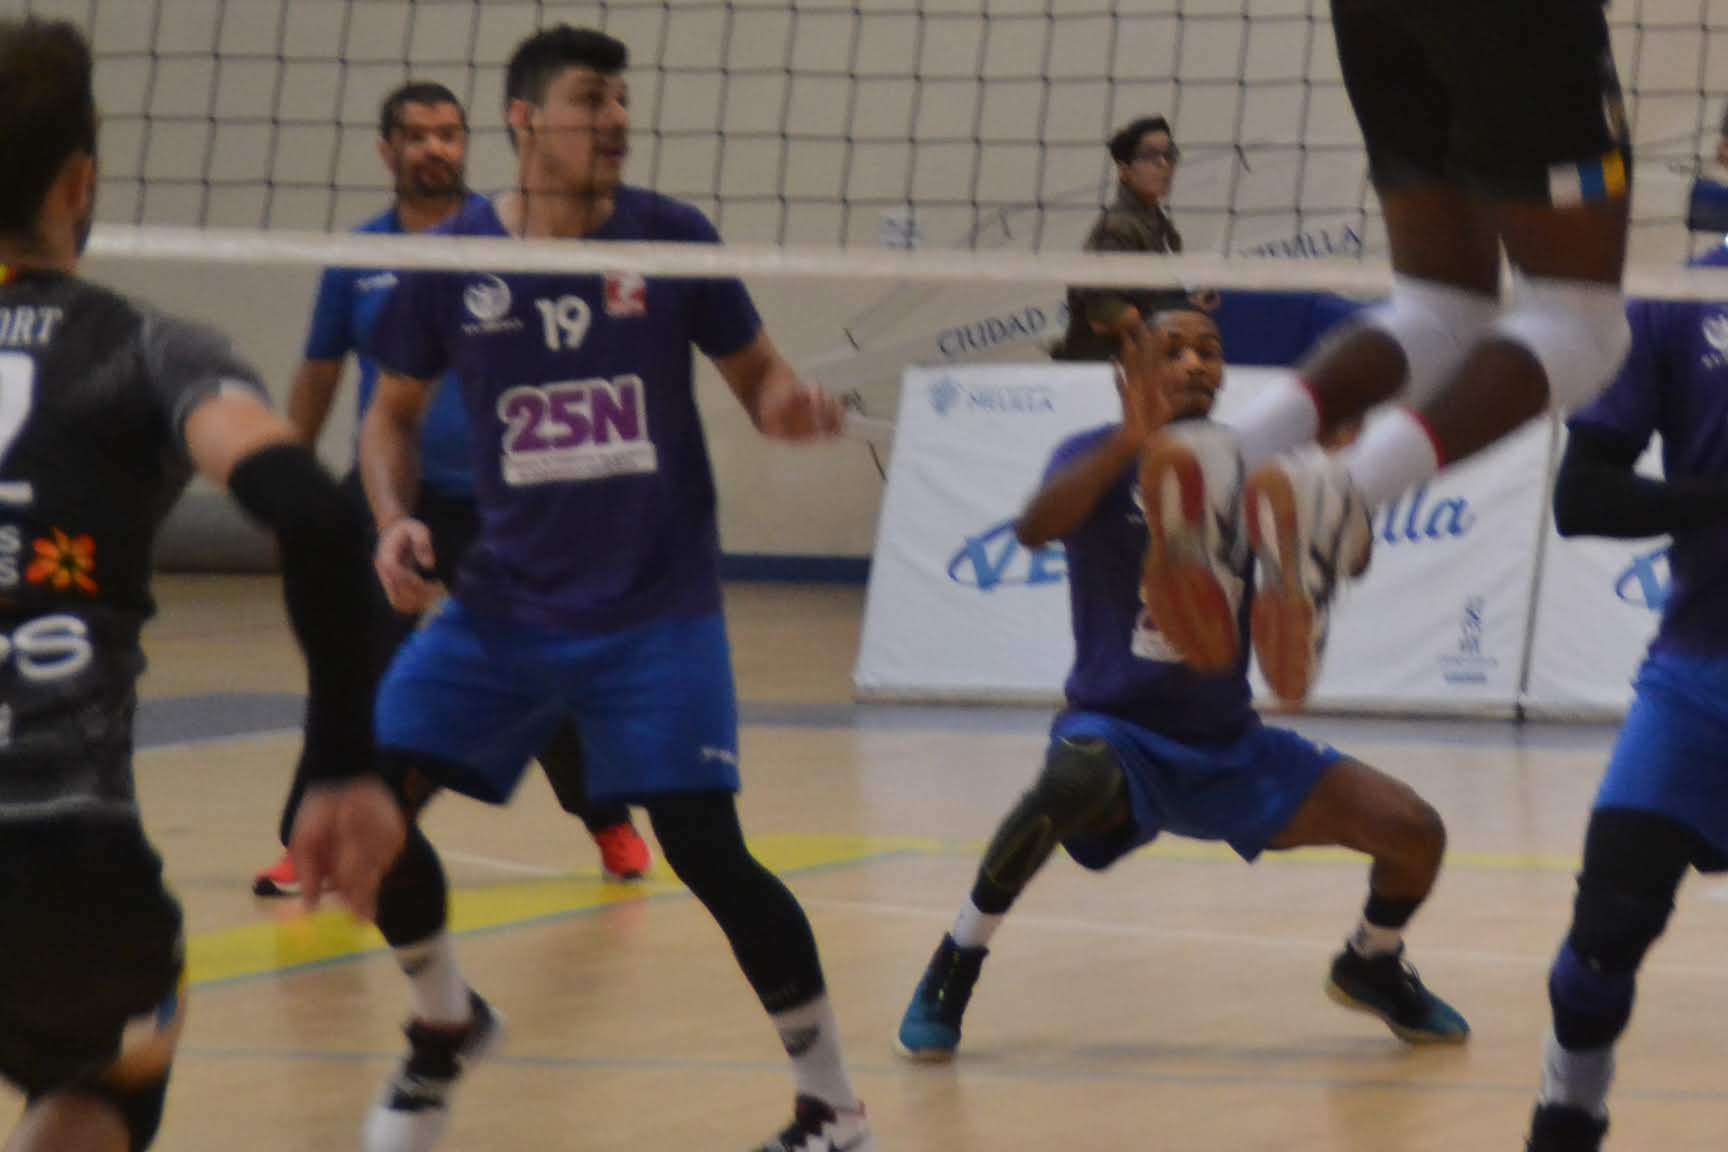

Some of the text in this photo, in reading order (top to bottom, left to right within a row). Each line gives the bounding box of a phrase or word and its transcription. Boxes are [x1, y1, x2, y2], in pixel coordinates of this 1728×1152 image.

[534, 294, 592, 350] 19
[934, 305, 1048, 356] CIUDAD
[503, 381, 643, 455] 25N
[963, 533, 1070, 592] VE
